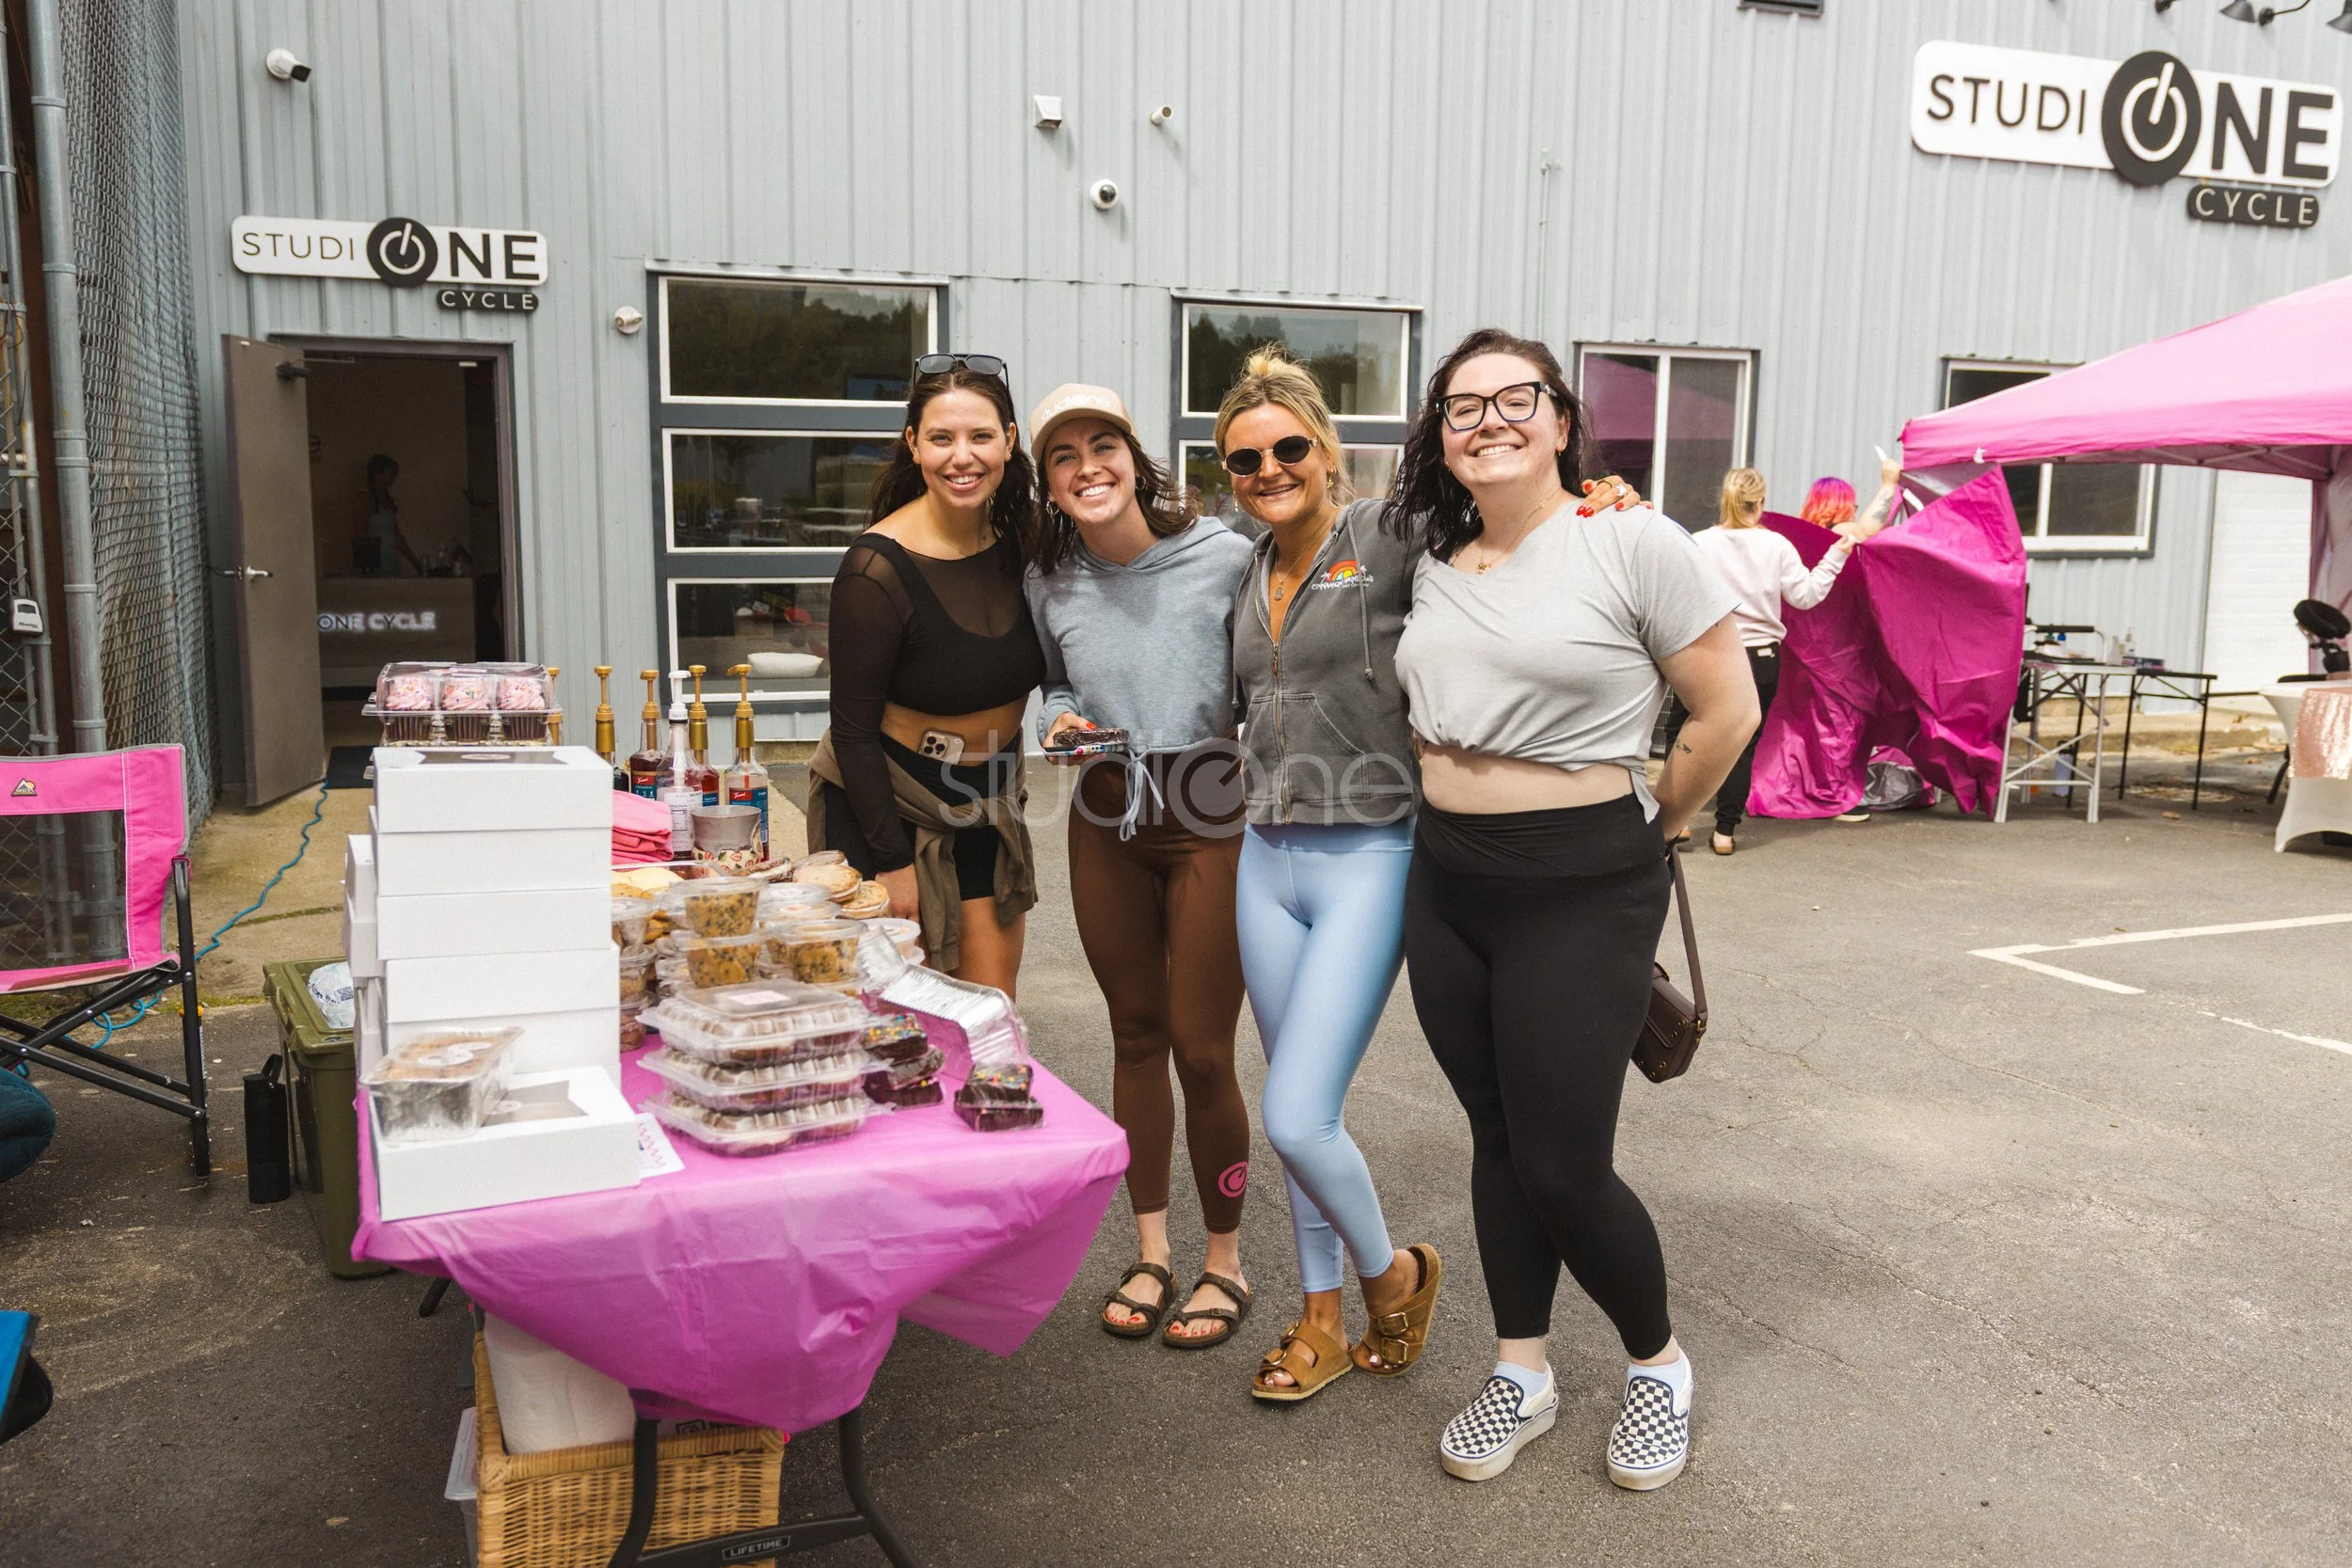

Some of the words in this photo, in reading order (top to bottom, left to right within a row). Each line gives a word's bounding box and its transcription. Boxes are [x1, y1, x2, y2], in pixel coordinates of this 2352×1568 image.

[2195, 187, 2316, 226] CYCLE
[440, 290, 535, 310] CYCLE
[317, 612, 364, 631] ONE
[369, 611, 436, 630] CYCLE
[730, 1539, 783, 1557] LIFETIME
